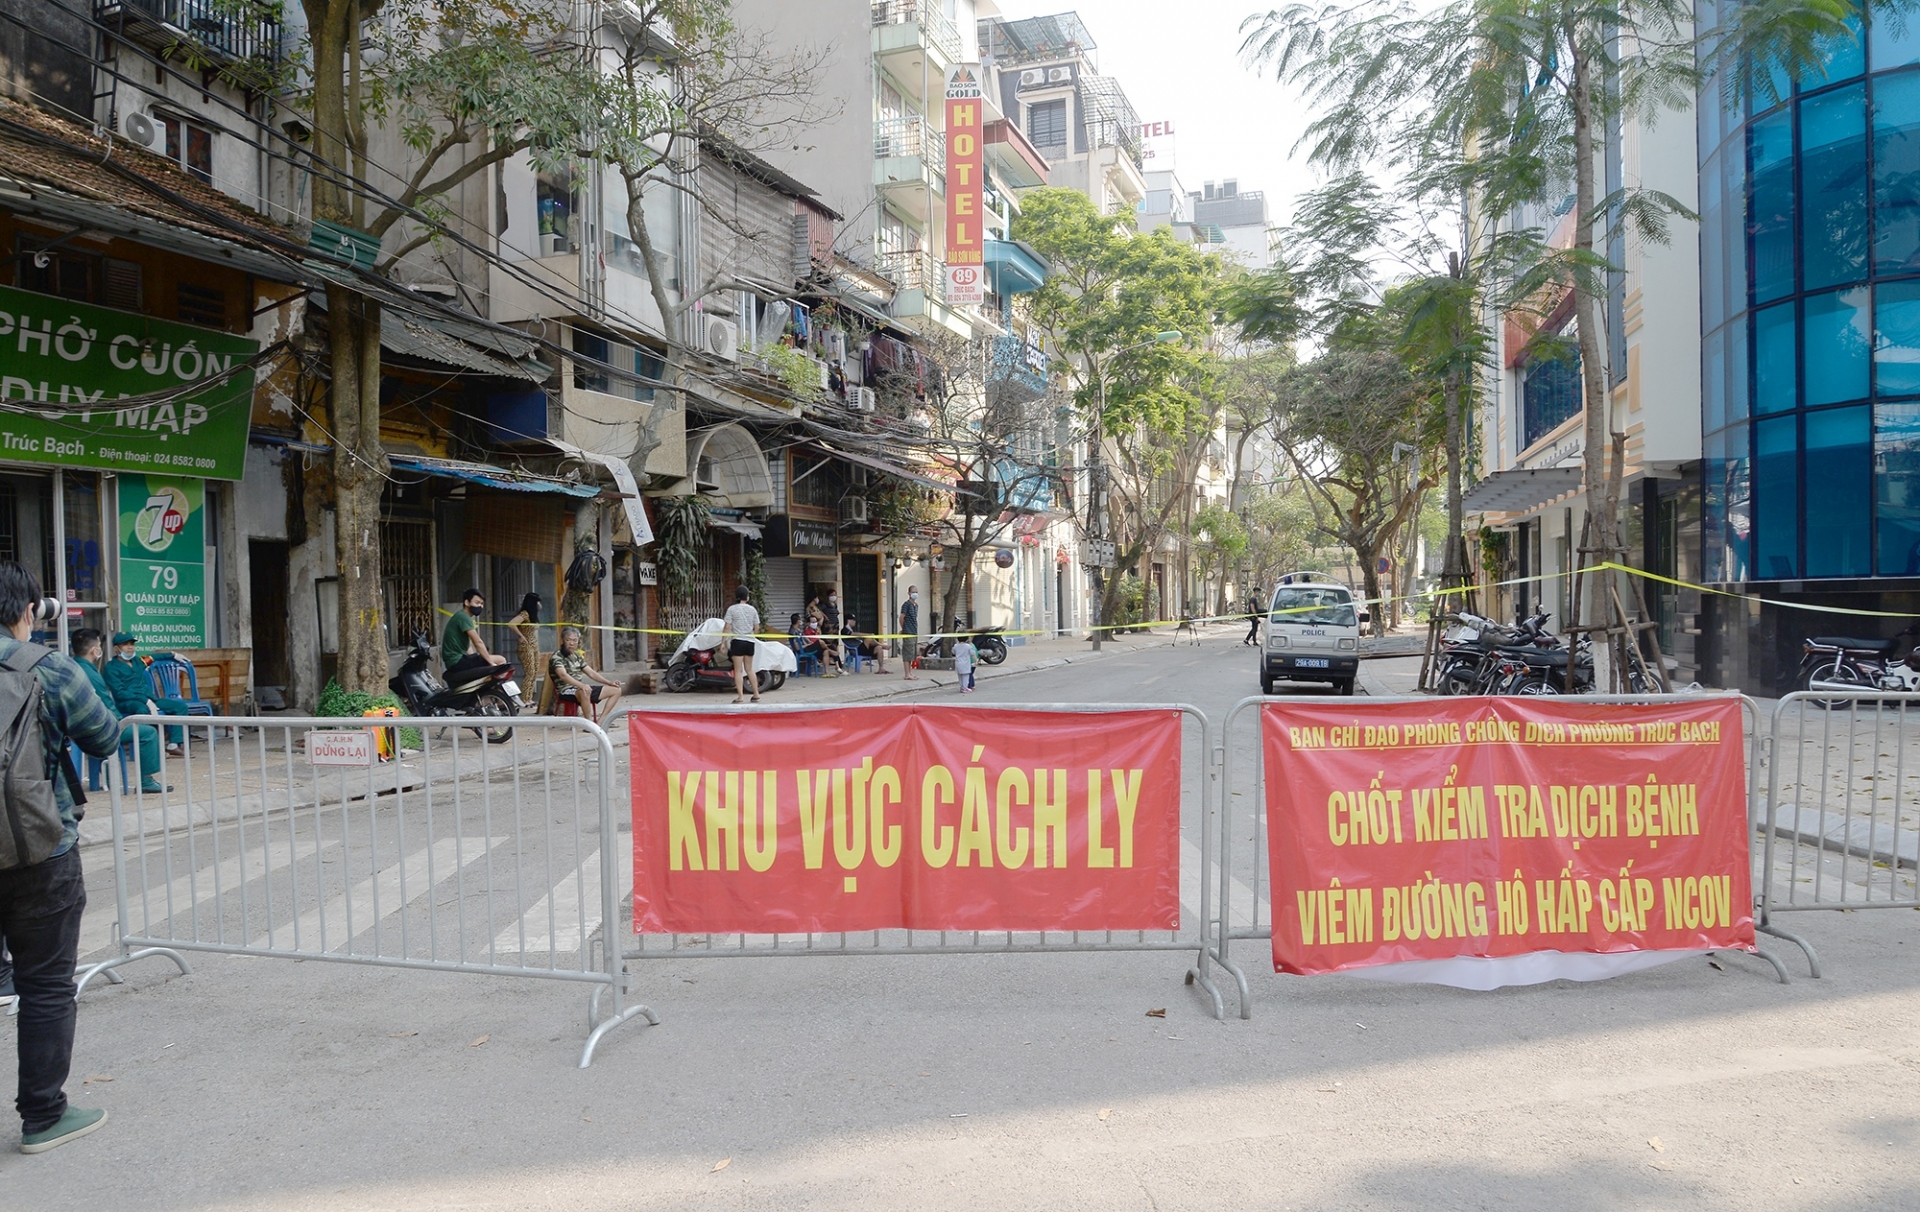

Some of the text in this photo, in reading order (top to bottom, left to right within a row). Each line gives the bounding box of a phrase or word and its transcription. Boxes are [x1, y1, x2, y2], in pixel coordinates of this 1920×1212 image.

[946, 89, 981, 98] GOLD
[1141, 121, 1174, 138] TEL
[953, 105, 974, 244] HOTEL
[956, 269, 974, 283] 89
[2, 432, 216, 469] Trúc Bạch Điện thoại: 024 8582 0800
[67, 538, 99, 568] 79
[149, 566, 178, 590] 79
[125, 592, 200, 606] QUÁN DUY MẬP
[146, 635, 170, 643] NGAN
[1290, 726, 1325, 748] BAN
[1330, 719, 1359, 747] CHỈ
[1364, 724, 1399, 750] ĐẠO
[1404, 719, 1461, 745] PHÒNG
[1465, 714, 1520, 742] CHỐNG
[1525, 721, 1566, 746] DỊCH
[1636, 719, 1676, 742] TRÚC
[1680, 721, 1720, 746] BẠCH
[315, 744, 366, 760] DỪNG LẠI
[667, 745, 1143, 893] KHU VỰC CÁCH LY
[1328, 764, 1699, 850] CHỐT KIỂM TRA DỊCH BỆNH
[1296, 860, 1730, 945] VIÊM ĐƯỜNG HÔ HẤP CẤP NCOV
